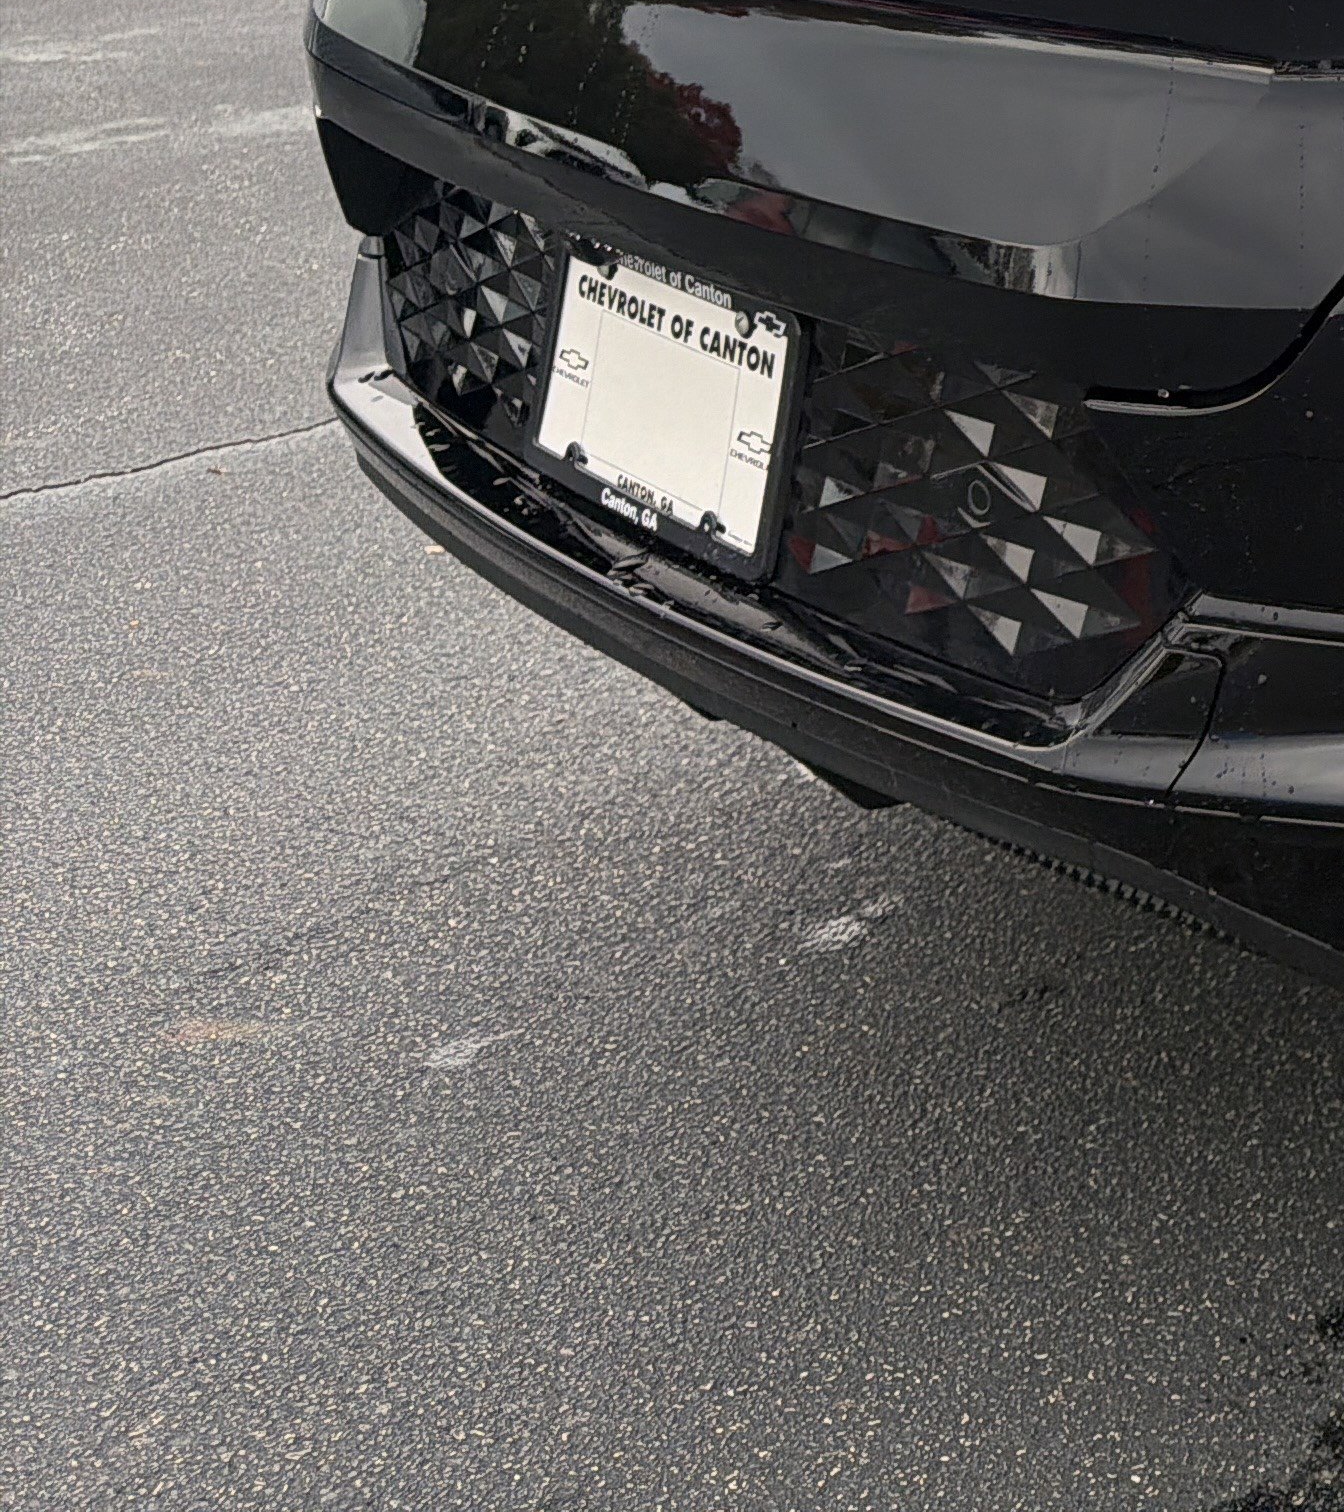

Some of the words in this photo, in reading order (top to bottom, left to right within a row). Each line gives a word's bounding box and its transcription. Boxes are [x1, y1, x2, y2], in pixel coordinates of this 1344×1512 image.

[669, 270, 683, 289] of
[684, 273, 732, 310] Canton
[578, 273, 666, 333] CHEVROLET
[670, 314, 695, 344] OF
[699, 326, 776, 380] CANTON
[601, 487, 639, 526] Canton,
[641, 508, 658, 532] GA
[660, 495, 674, 517] GA
